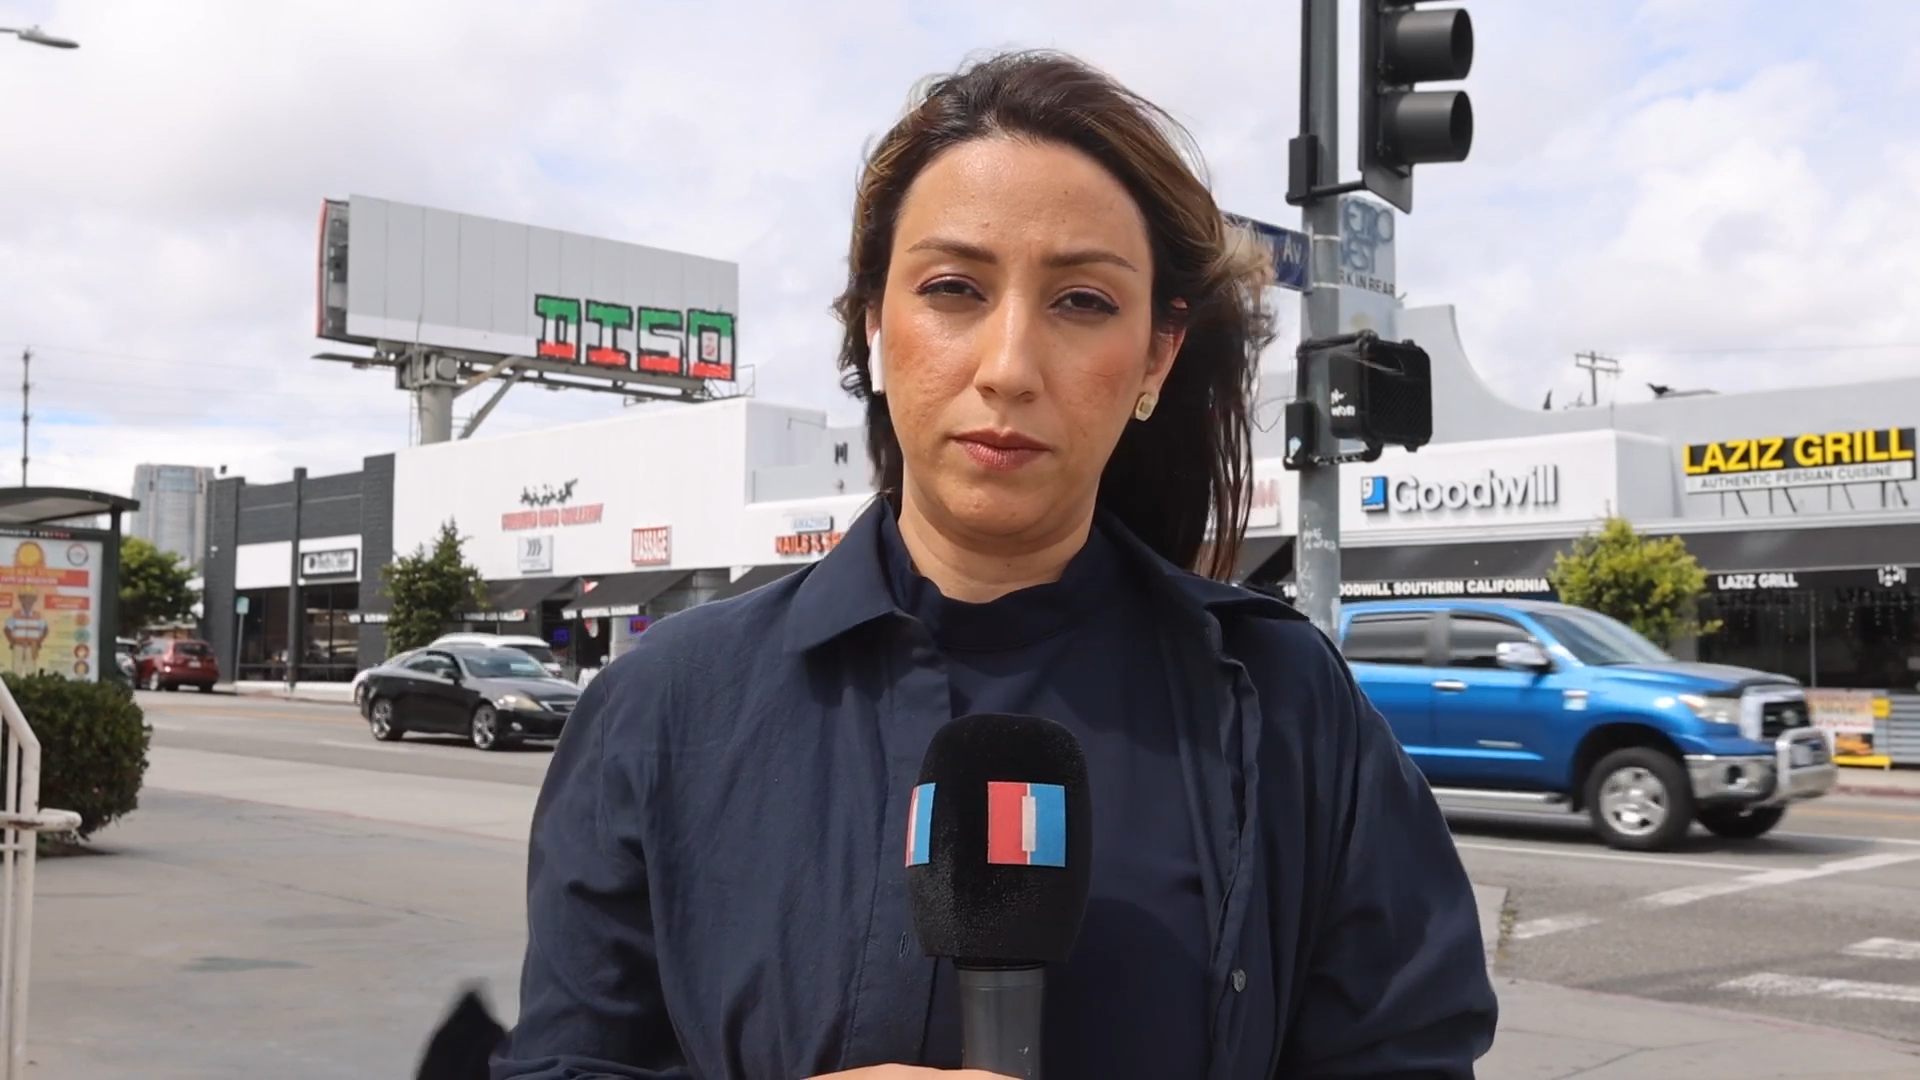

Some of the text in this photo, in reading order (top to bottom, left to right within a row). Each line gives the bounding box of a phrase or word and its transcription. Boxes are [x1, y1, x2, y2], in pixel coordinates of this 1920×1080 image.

[535, 294, 736, 381] DISO
[1683, 427, 1914, 474] LAZIZ GRILL
[1393, 464, 1558, 513] Goodwill
[1701, 465, 1892, 489] AUTHENTIC PERSIAN CUISINE
[633, 529, 667, 561] MASSAGE
[776, 534, 811, 554] NAILS
[1393, 579, 1464, 595] SOUTHERN
[1466, 577, 1550, 593] CALIFORNIA
[1718, 573, 1798, 589] LAZIZ GRILL
